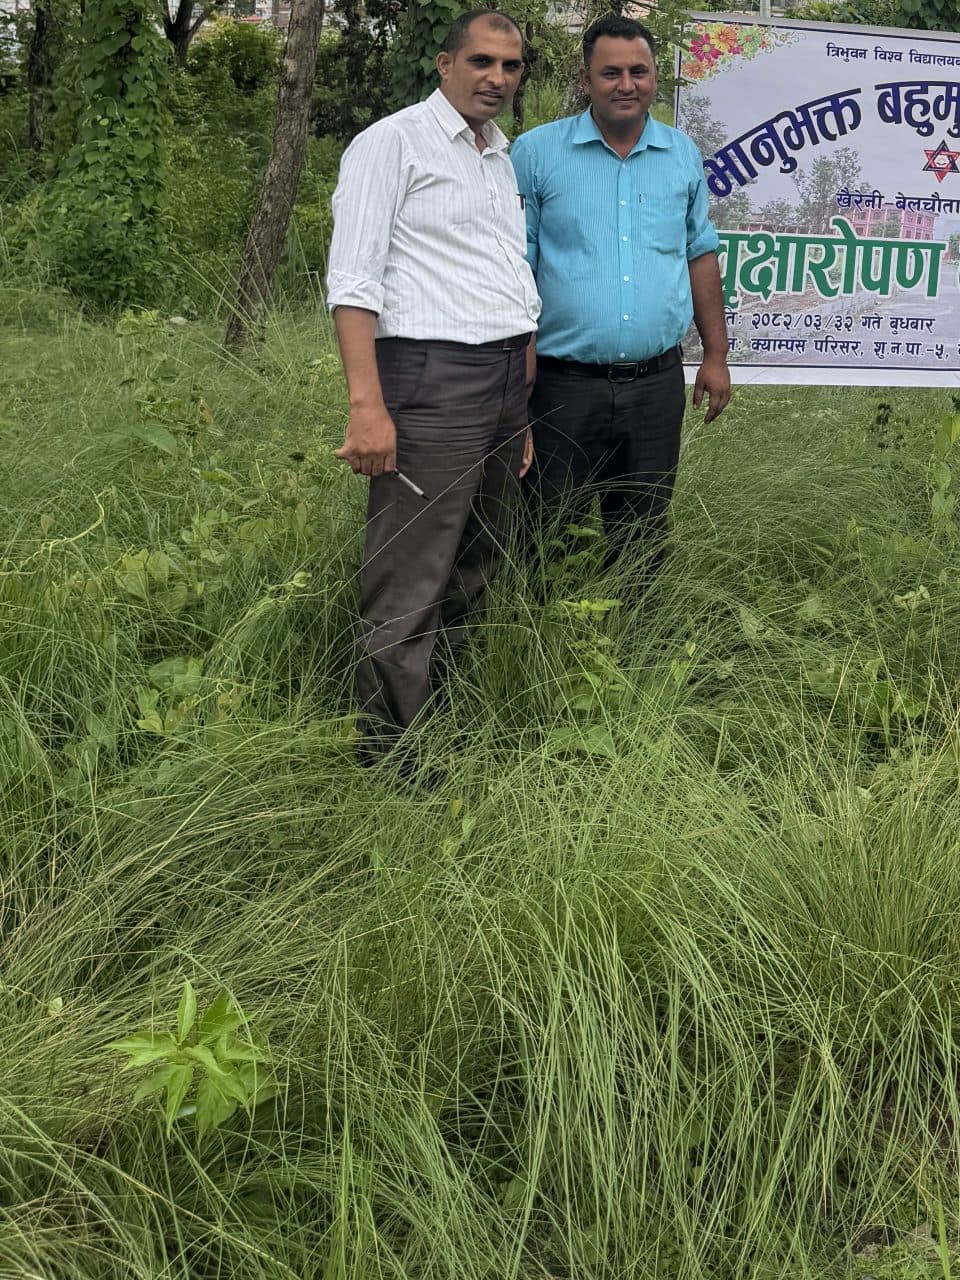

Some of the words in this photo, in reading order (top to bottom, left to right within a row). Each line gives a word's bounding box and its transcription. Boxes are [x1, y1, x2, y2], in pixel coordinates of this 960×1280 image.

[826, 43, 868, 62] त्रिभुवन
[874, 47, 903, 63] विश्व
[703, 88, 861, 197] भानुभक्त
[751, 313, 854, 331] २०८२/०३/३२
[862, 313, 882, 330] गते
[751, 338, 807, 353] क्याम्पस
[814, 335, 864, 357] परिसर,
